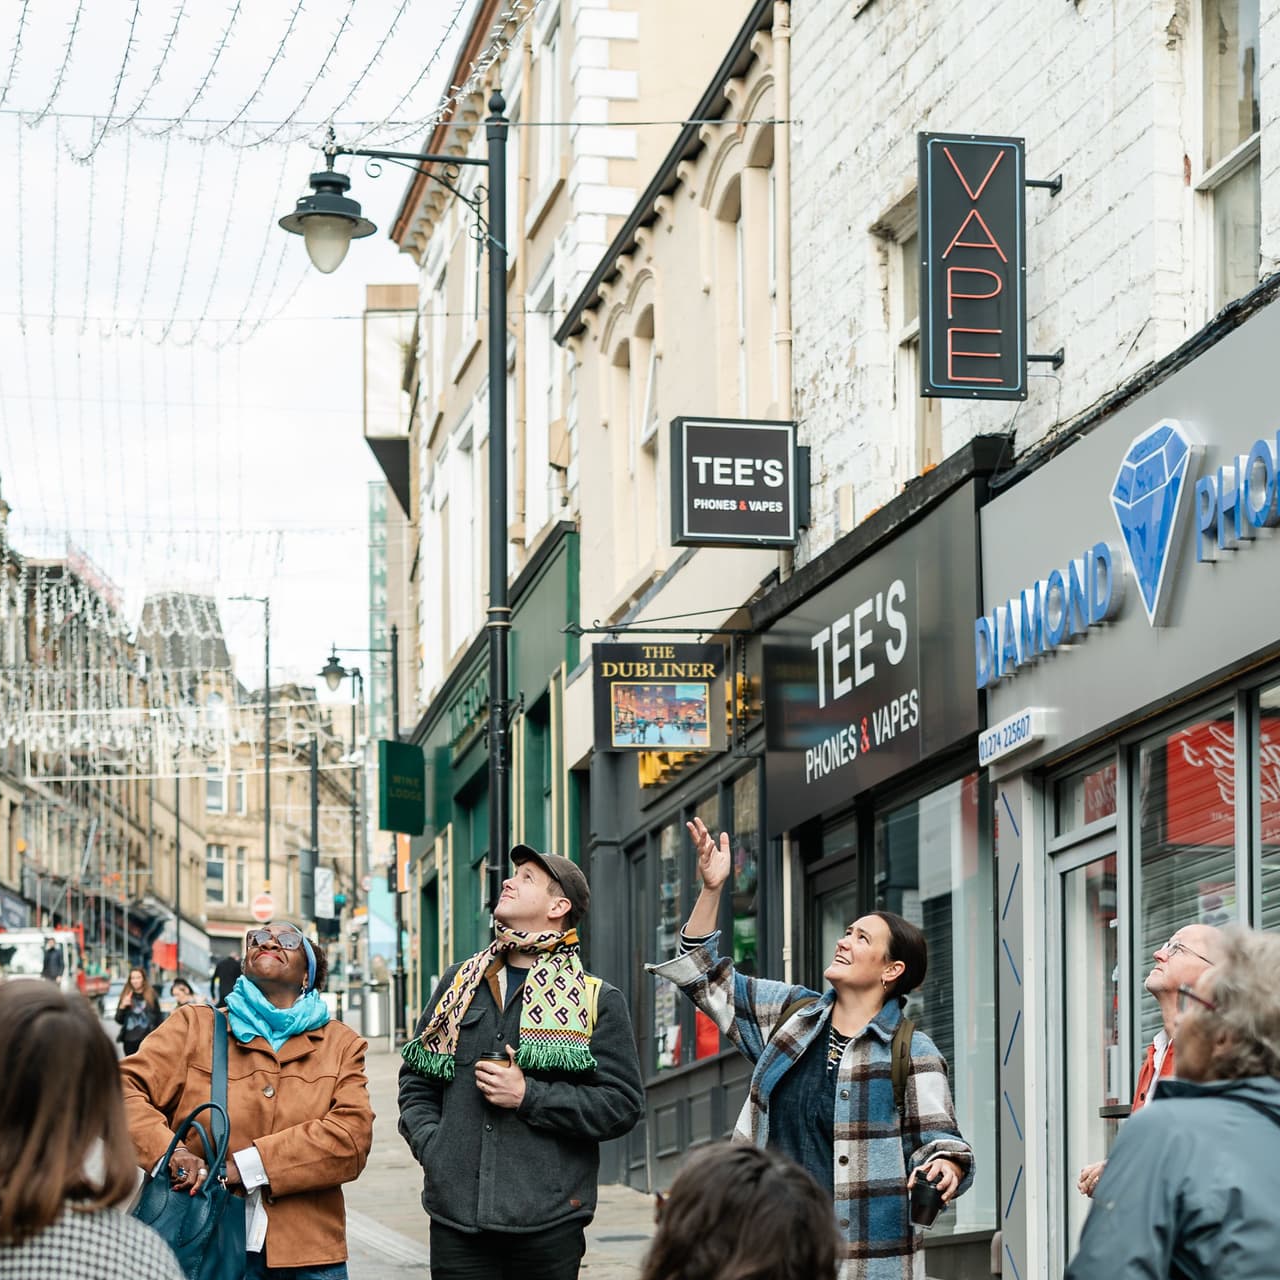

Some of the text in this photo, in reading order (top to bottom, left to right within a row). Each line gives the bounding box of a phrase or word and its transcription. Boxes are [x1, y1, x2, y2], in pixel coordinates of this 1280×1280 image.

[943, 147, 1008, 383] VAPE
[692, 456, 784, 487] TEE'S
[694, 498, 784, 512] PHONES & VAPES
[975, 541, 1116, 690] DIAMOND
[642, 645, 676, 659] THE
[811, 578, 908, 710] TEE'S
[601, 662, 716, 678] DUBLINER
[806, 688, 919, 784] PHONES & VAPES
[980, 714, 1031, 760] 01274 225607
